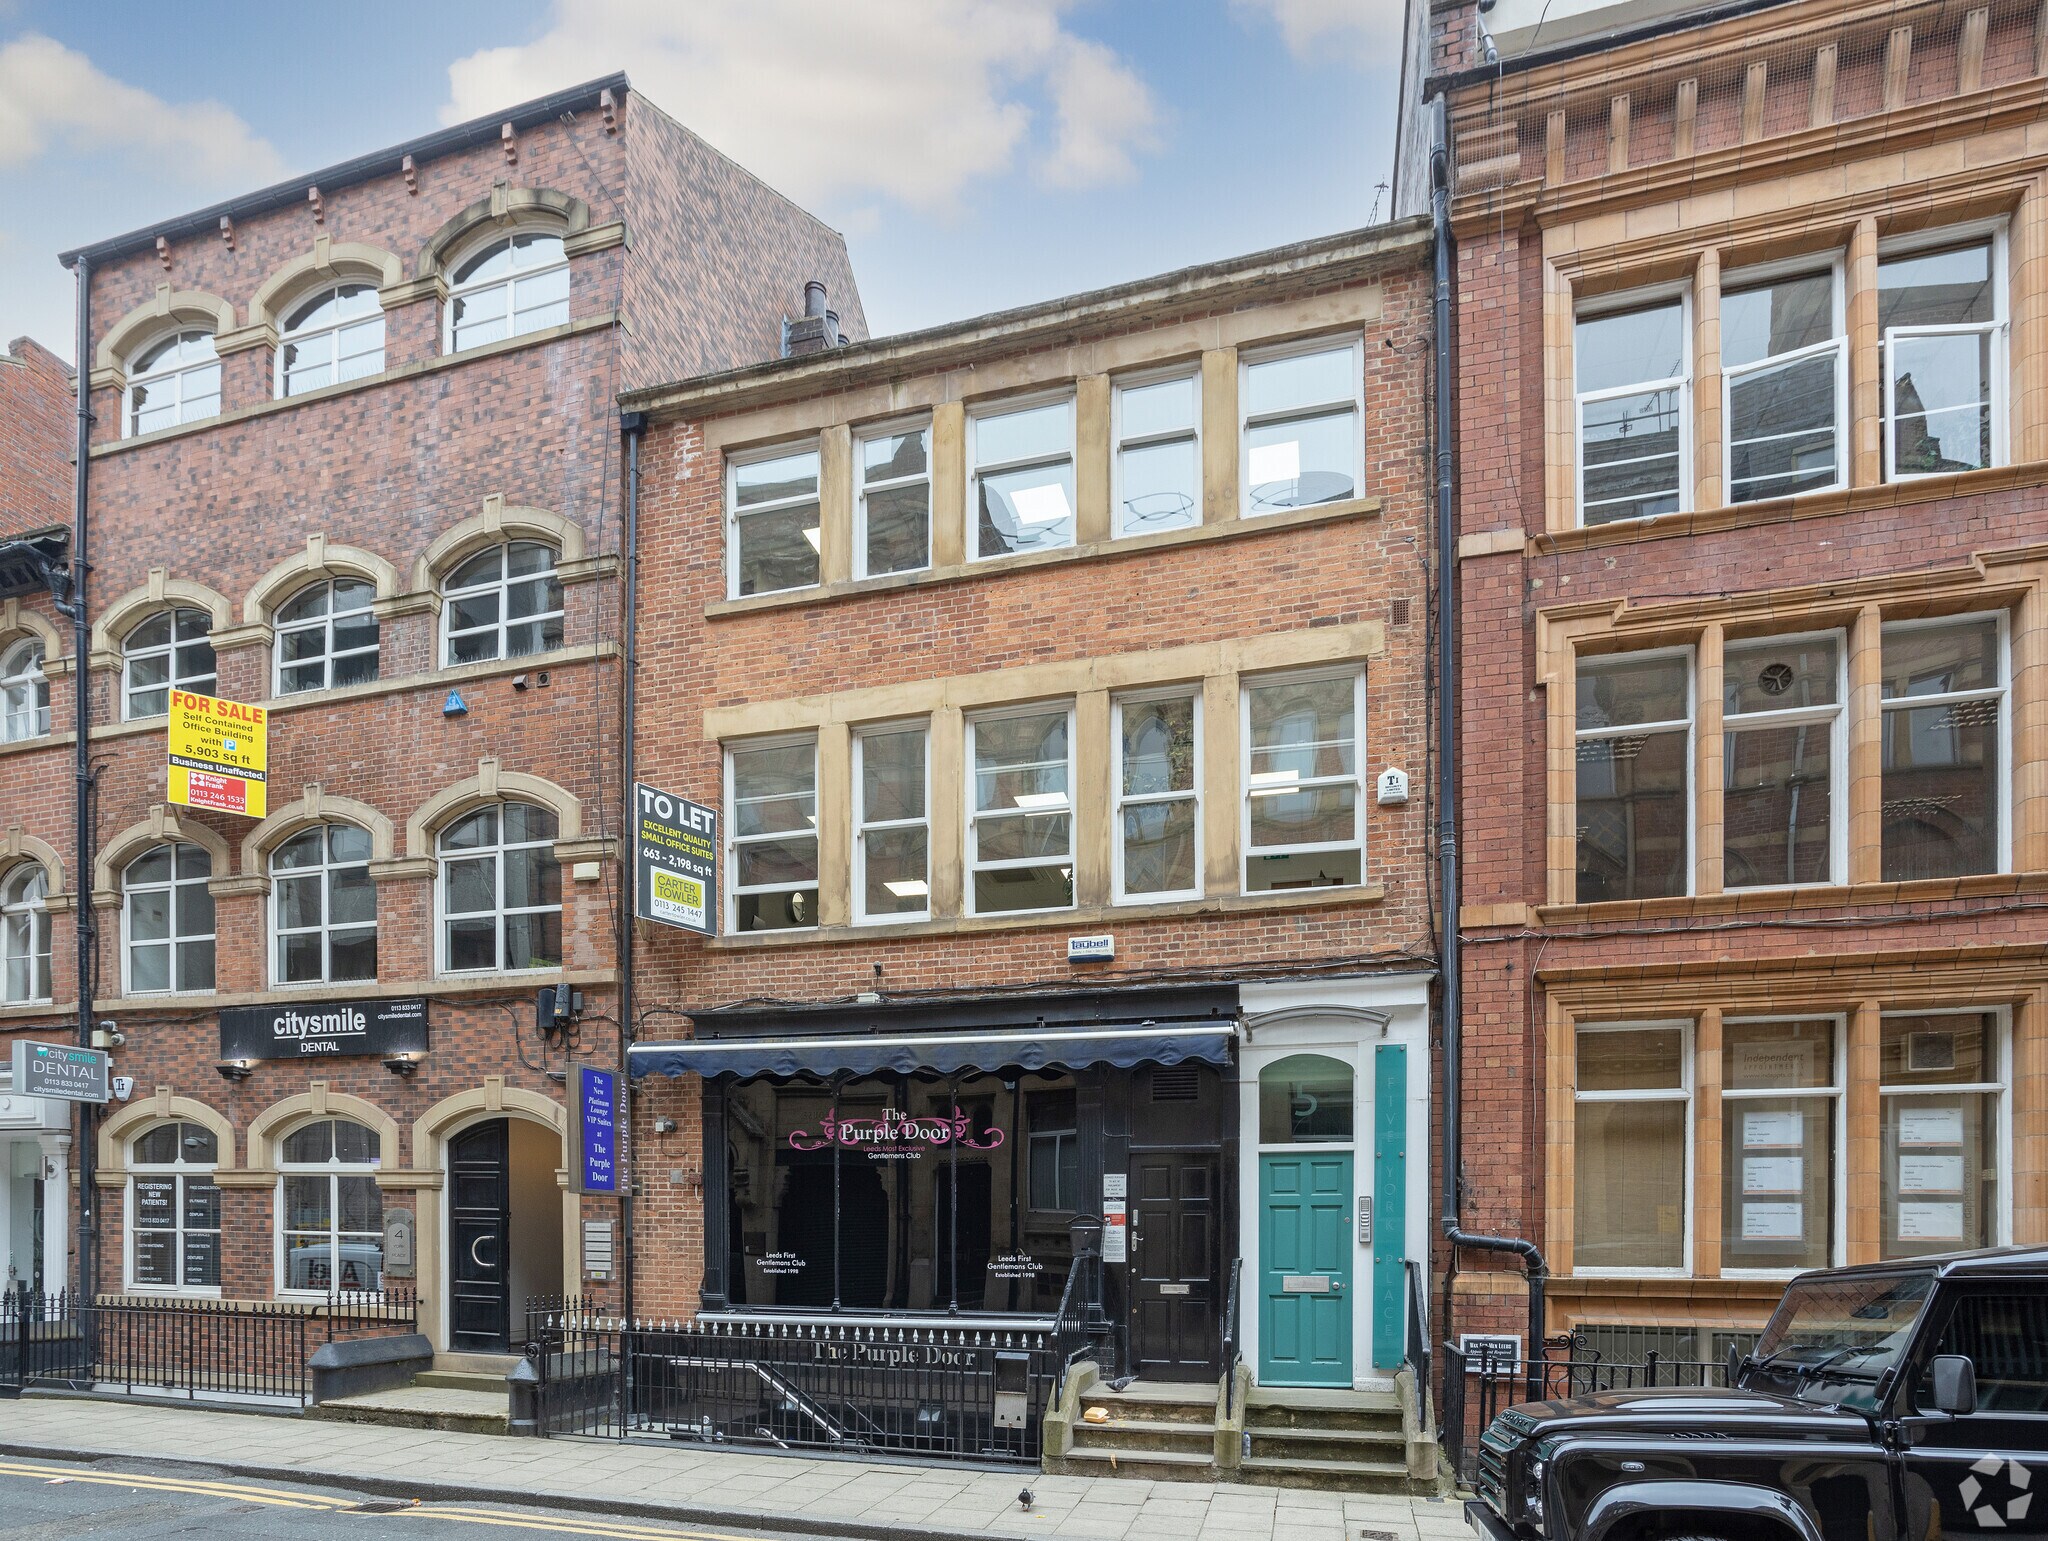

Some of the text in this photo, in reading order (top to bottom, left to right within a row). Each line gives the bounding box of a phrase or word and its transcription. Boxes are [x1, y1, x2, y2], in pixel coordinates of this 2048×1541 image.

[173, 692, 262, 724] FOR SALE
[184, 713, 253, 732] Self Contained
[183, 722, 253, 742] Office Building
[201, 737, 221, 746] with
[186, 745, 250, 764] 5,903 sq ft
[172, 757, 264, 780] Business Unaffected.
[205, 782, 224, 790] Frank
[206, 775, 227, 784] Knight
[191, 789, 244, 804] 0113 246 1533
[641, 789, 713, 834] TO LET
[644, 820, 711, 848] EXCELLENT QUALITY
[641, 831, 713, 860] SMALL OFFICE SUITES
[643, 848, 660, 860] 663
[669, 855, 691, 870] 2,198
[693, 864, 703, 876] sq
[705, 866, 711, 876] ft
[658, 876, 696, 894] CARTER
[658, 886, 699, 906] TOWLER
[655, 899, 702, 918] 0113 245 1447
[1071, 939, 1108, 950] taybell
[378, 1012, 422, 1020] citysmiledental.com
[274, 1008, 366, 1039] citysmile
[301, 1042, 339, 1053] DENTAL
[1744, 1053, 1803, 1064] Independent
[33, 1060, 99, 1080] DENTAL
[45, 1078, 60, 1086] 0113
[594, 1076, 603, 1085] The
[34, 1086, 98, 1098] citysmiledental.com
[594, 1086, 604, 1095] New
[620, 1080, 628, 1113] Door
[588, 1096, 609, 1107] Platinum
[1295, 1081, 1318, 1117] 5
[590, 1106, 608, 1116] Lounge
[882, 1108, 907, 1121] The
[587, 1116, 612, 1127] VIP Suites
[841, 1123, 949, 1143] Purple Door
[594, 1143, 606, 1153] The
[590, 1157, 610, 1170] Purple
[592, 1171, 608, 1182] Door
[395, 1230, 403, 1239] 4
[792, 1259, 806, 1267] Club
[1027, 1262, 1043, 1270] Club
[814, 1342, 848, 1360] The
[853, 1343, 919, 1367] Purple
